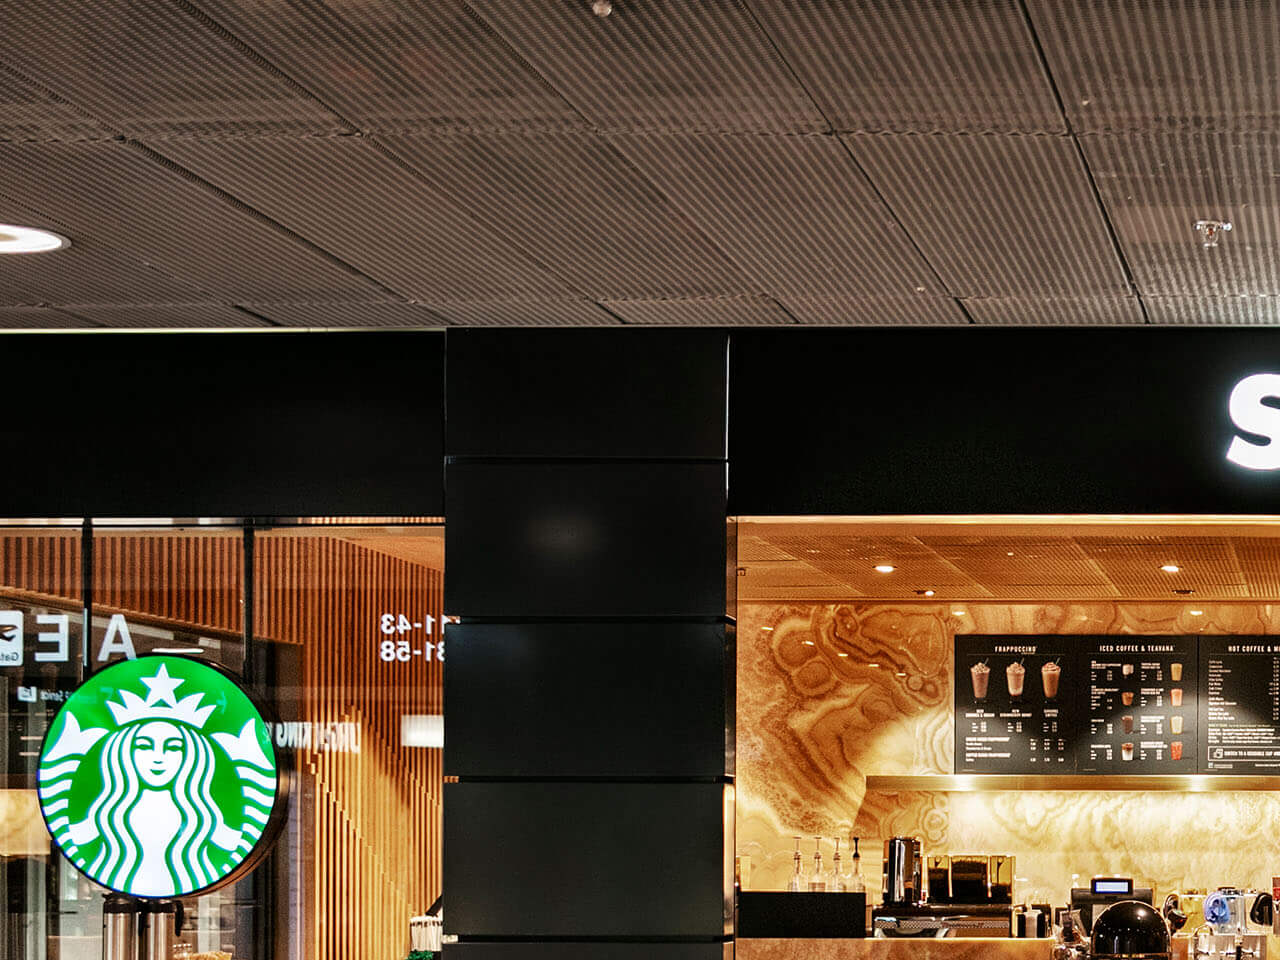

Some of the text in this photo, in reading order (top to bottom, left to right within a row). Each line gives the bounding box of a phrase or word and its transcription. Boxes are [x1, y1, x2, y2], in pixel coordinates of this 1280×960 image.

[994, 645, 1036, 653] FRAPPUCCINO
[1228, 645, 1240, 653] HOT
[1242, 645, 1265, 653] COFFEE
